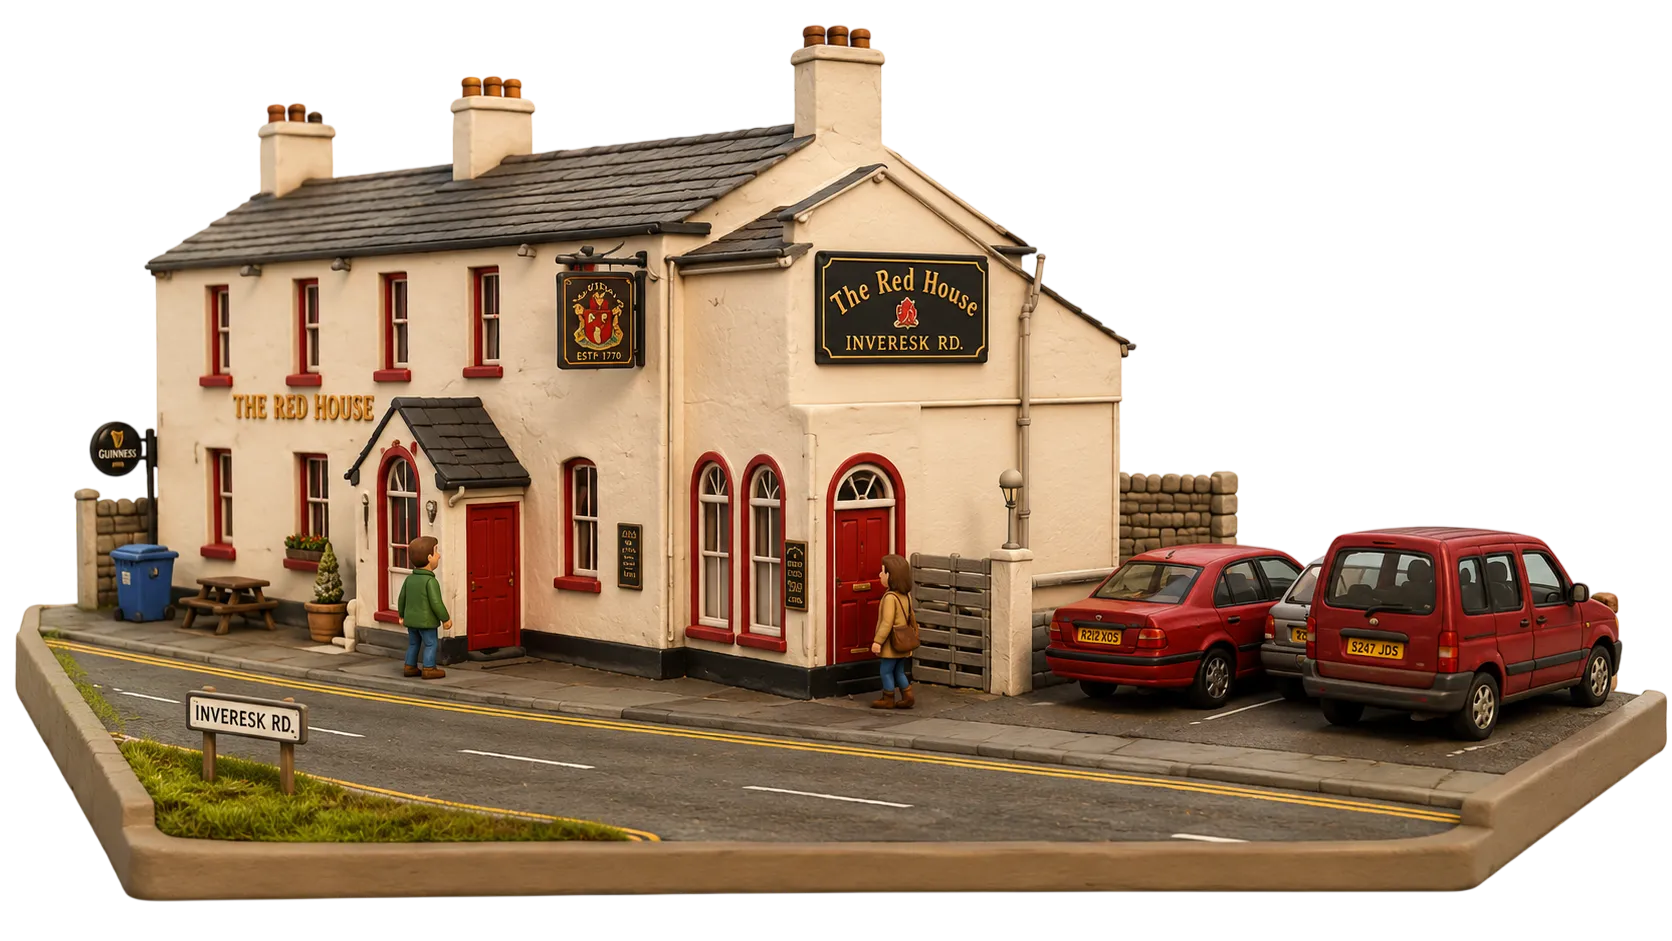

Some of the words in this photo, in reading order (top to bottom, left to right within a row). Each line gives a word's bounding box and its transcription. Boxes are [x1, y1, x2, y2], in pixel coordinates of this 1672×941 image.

[829, 283, 870, 316] The
[875, 267, 915, 295] Red
[922, 269, 978, 317] House
[845, 335, 930, 351] INVERESK
[938, 335, 964, 351] RD.
[602, 351, 622, 360] 1770
[232, 393, 268, 420] THE
[273, 393, 309, 420] RED
[313, 393, 375, 422] HOUSE
[98, 448, 137, 459] GUINNESS
[1080, 629, 1100, 642] R212
[1101, 631, 1119, 643] XOS
[1351, 641, 1376, 654] S247
[1377, 644, 1399, 657] JDS
[195, 704, 266, 730] INVERESK
[271, 713, 295, 734] RD.
